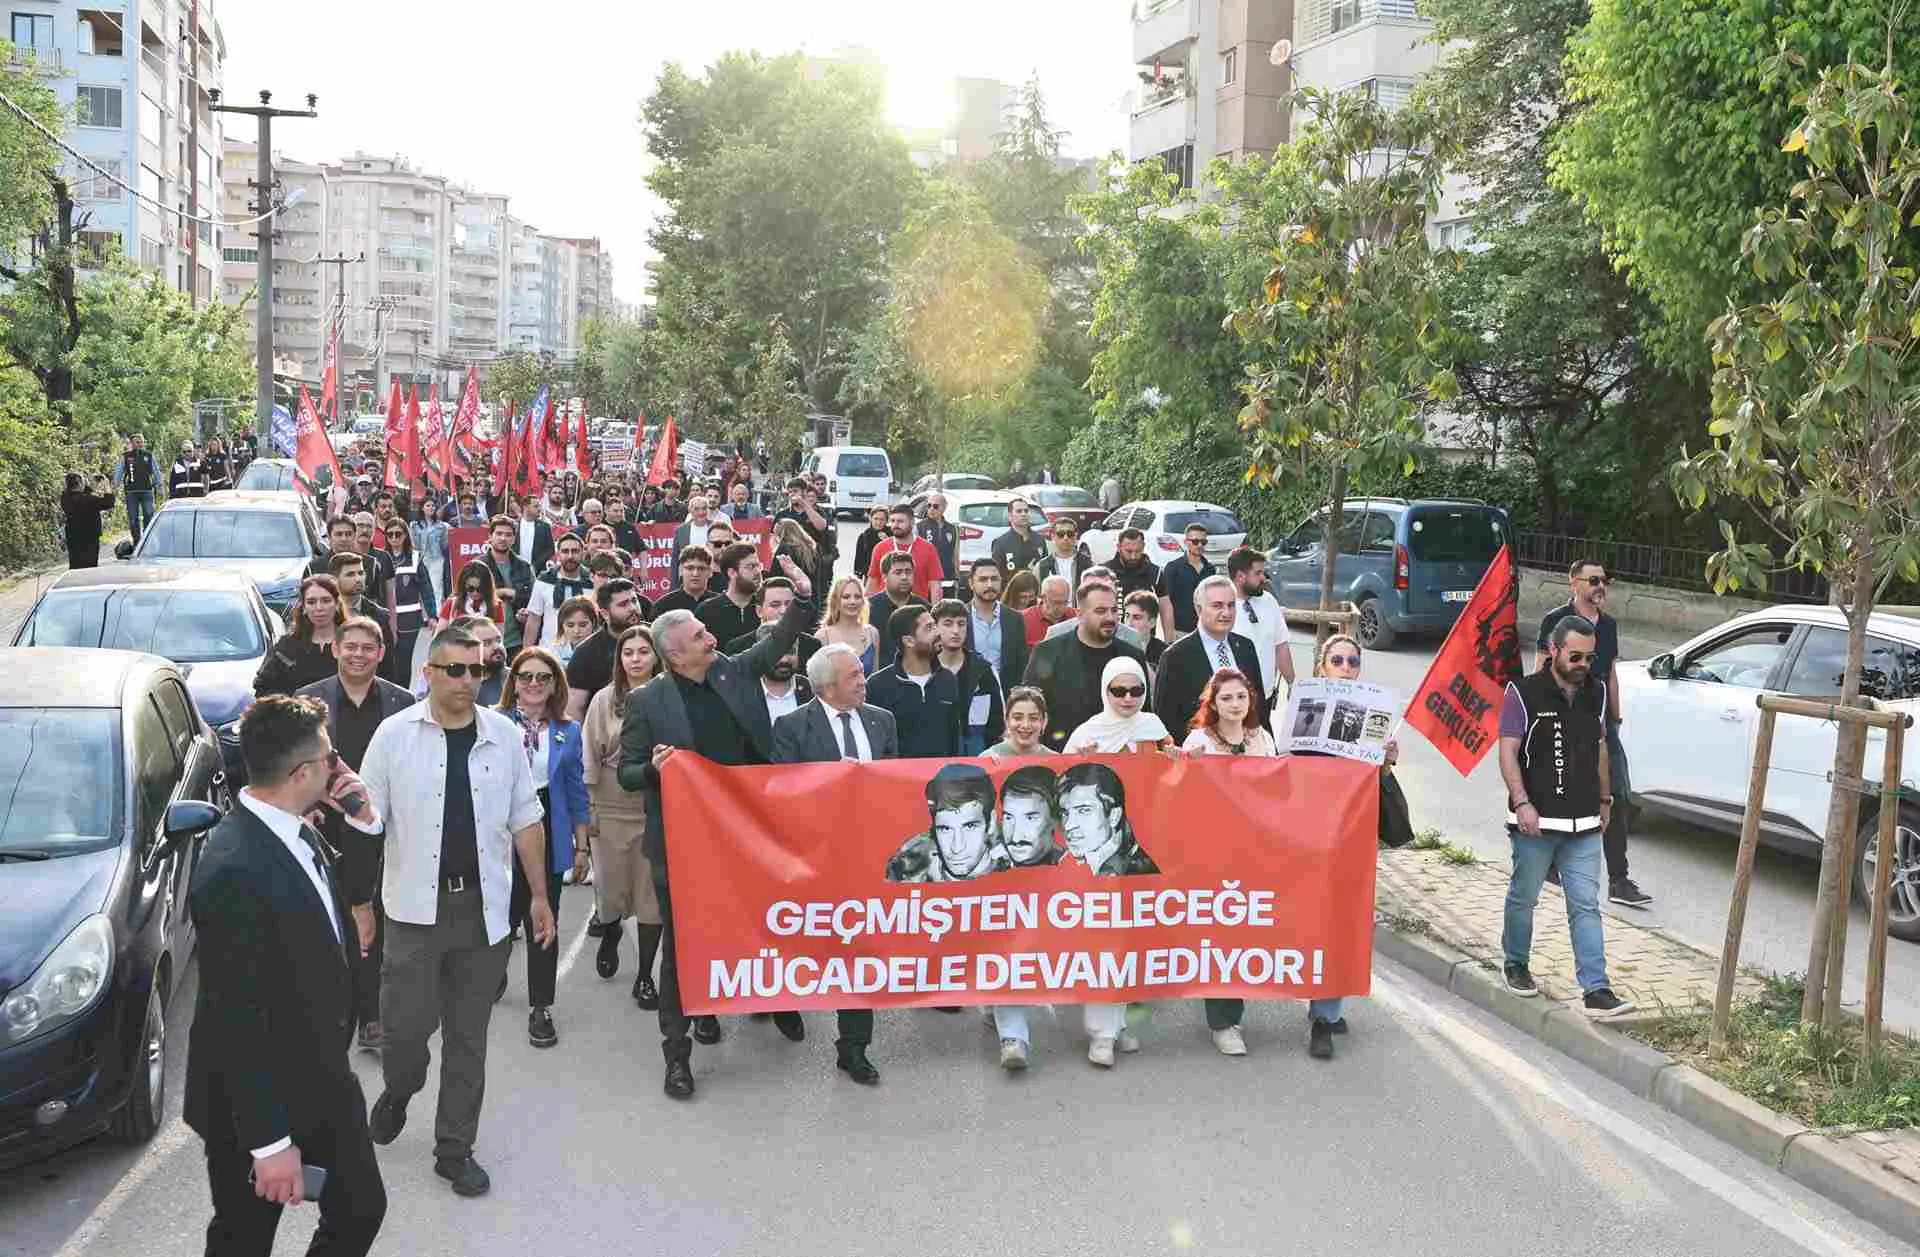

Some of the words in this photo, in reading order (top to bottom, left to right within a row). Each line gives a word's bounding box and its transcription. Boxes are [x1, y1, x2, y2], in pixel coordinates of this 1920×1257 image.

[1448, 671, 1493, 724] EMEK
[766, 889, 1039, 944] GEÇMİŞTEN
[1046, 879, 1275, 929] GELECEĞE
[708, 948, 968, 998] MÜCADELE
[975, 951, 1137, 991] DEVAM
[1144, 938, 1305, 985] EDİYOR
[1312, 949, 1324, 985] !
